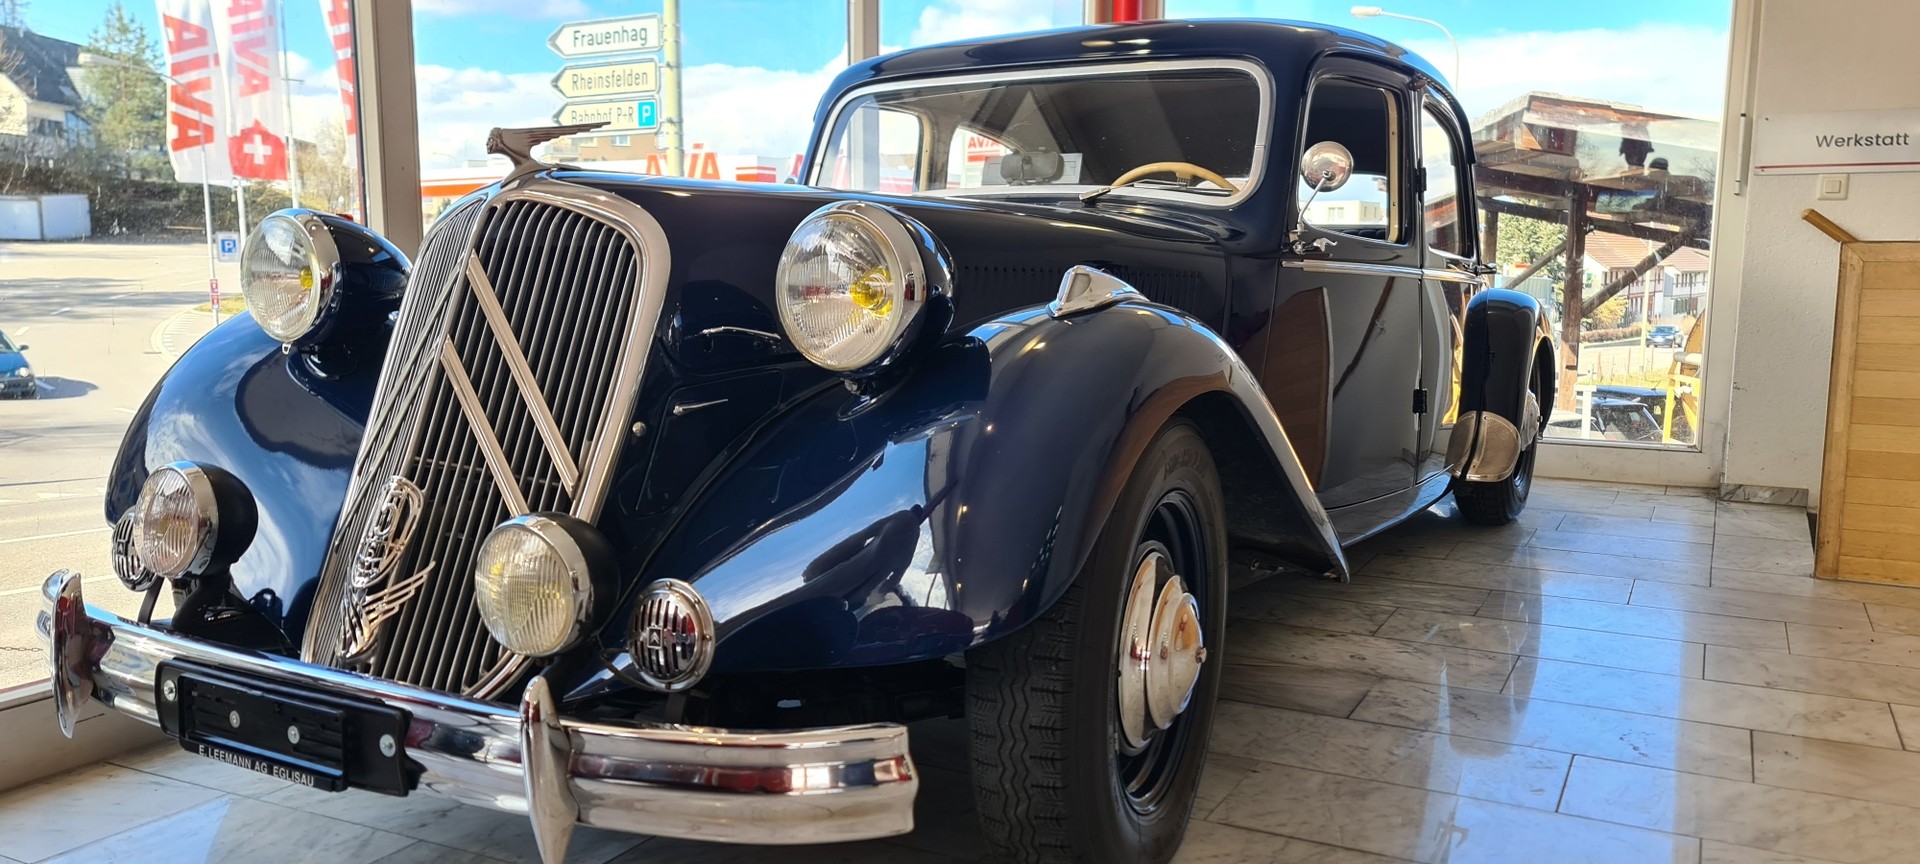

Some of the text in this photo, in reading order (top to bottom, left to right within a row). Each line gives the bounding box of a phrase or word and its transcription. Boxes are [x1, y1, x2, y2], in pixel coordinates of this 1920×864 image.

[573, 26, 647, 47] Frauenhag
[572, 69, 648, 91] Rheinsfelden
[1815, 133, 1910, 148] Werkstatt
[208, 747, 252, 770] LEEMANN
[254, 762, 268, 775] AG
[273, 766, 314, 787] EGLISAU
